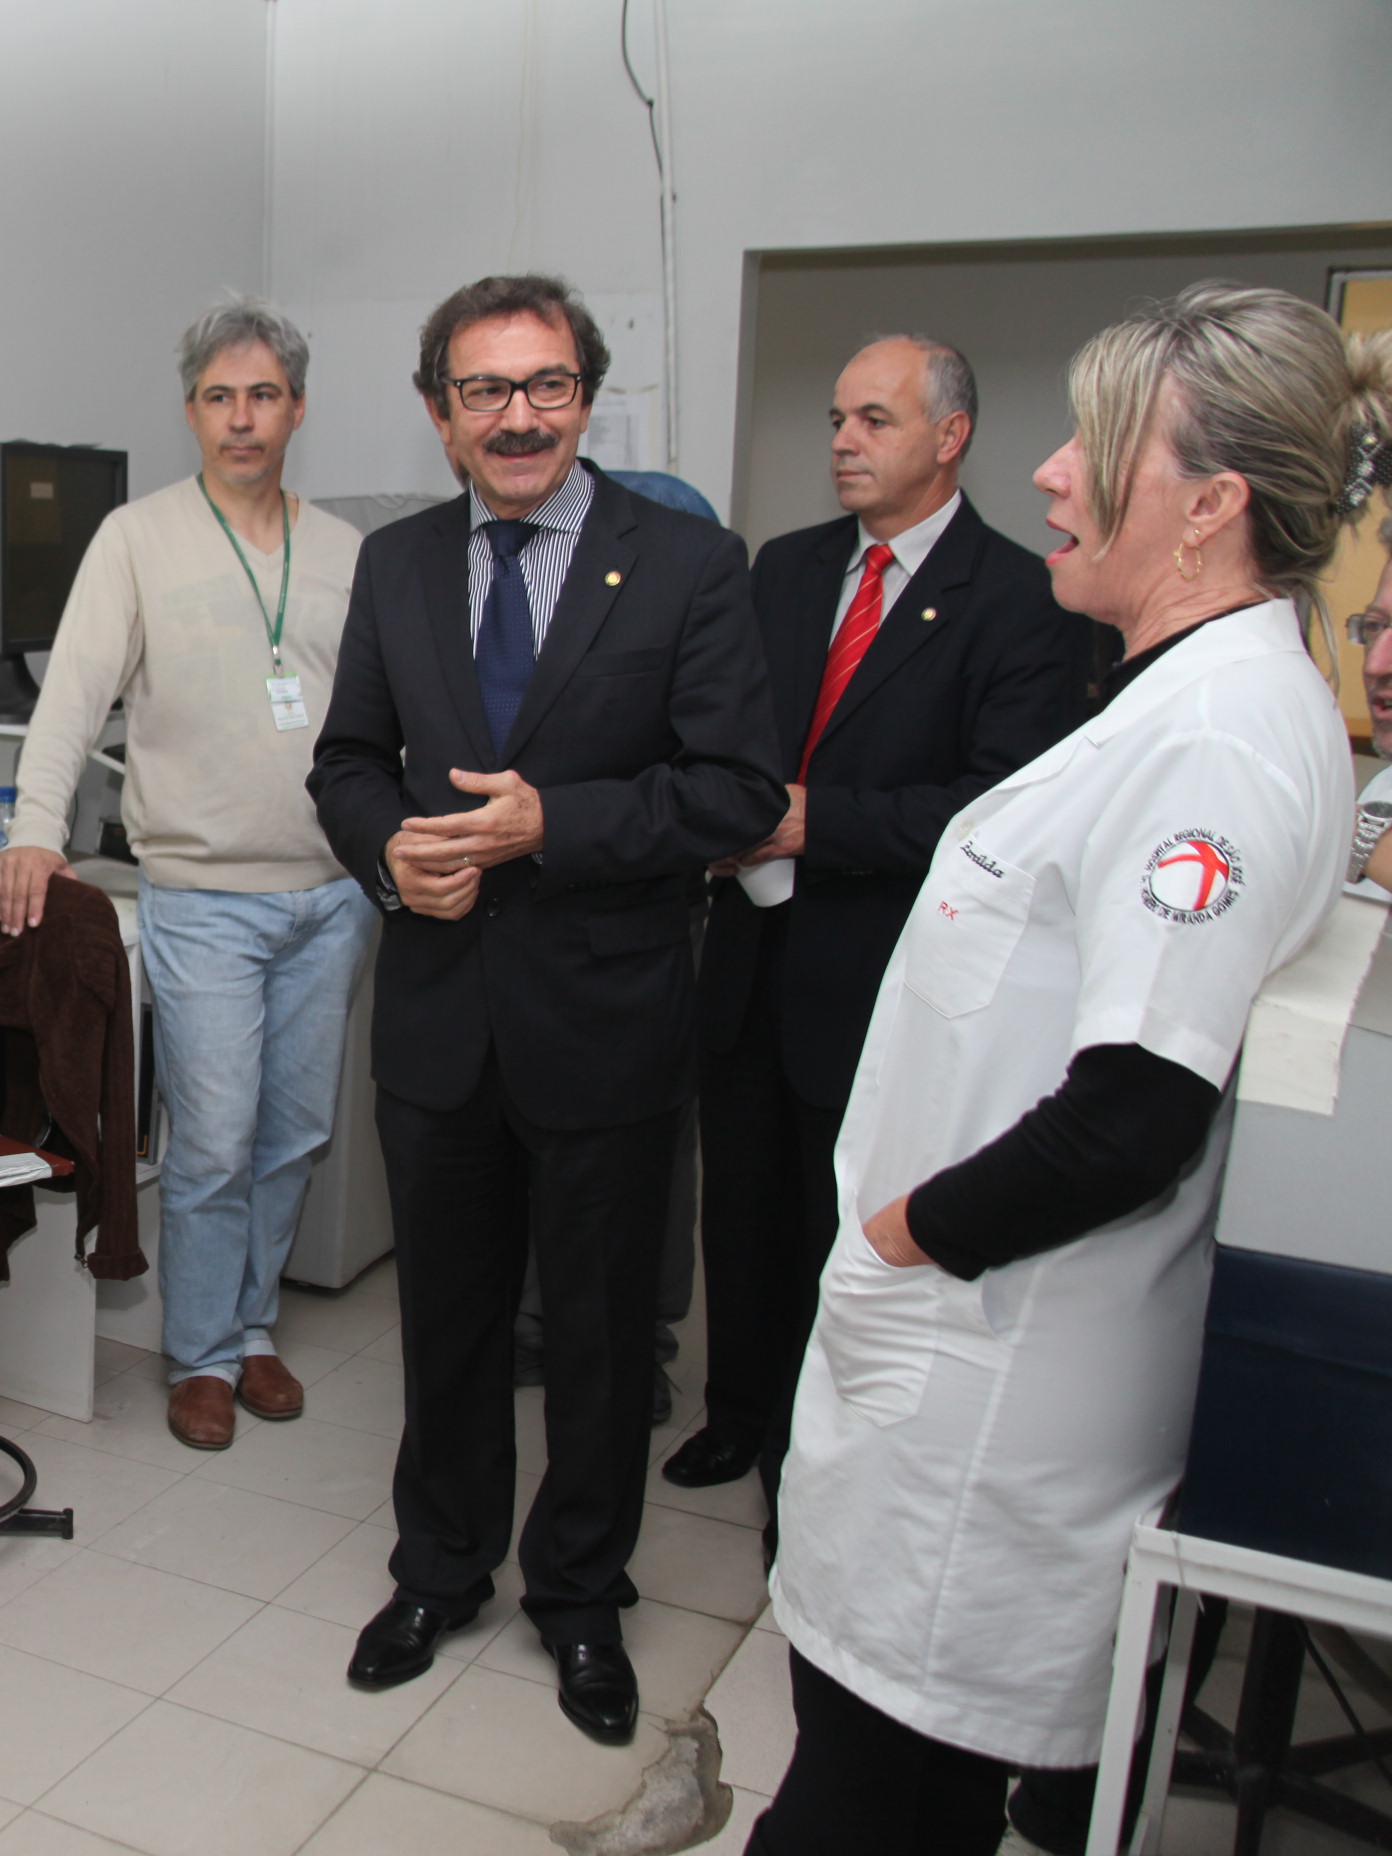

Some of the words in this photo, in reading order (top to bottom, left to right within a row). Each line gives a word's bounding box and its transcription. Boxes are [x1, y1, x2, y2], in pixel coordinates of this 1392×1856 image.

[1144, 837, 1173, 871] HOSPITAL
[937, 900, 960, 921] RX
[1172, 910, 1214, 925] MIRANDA
